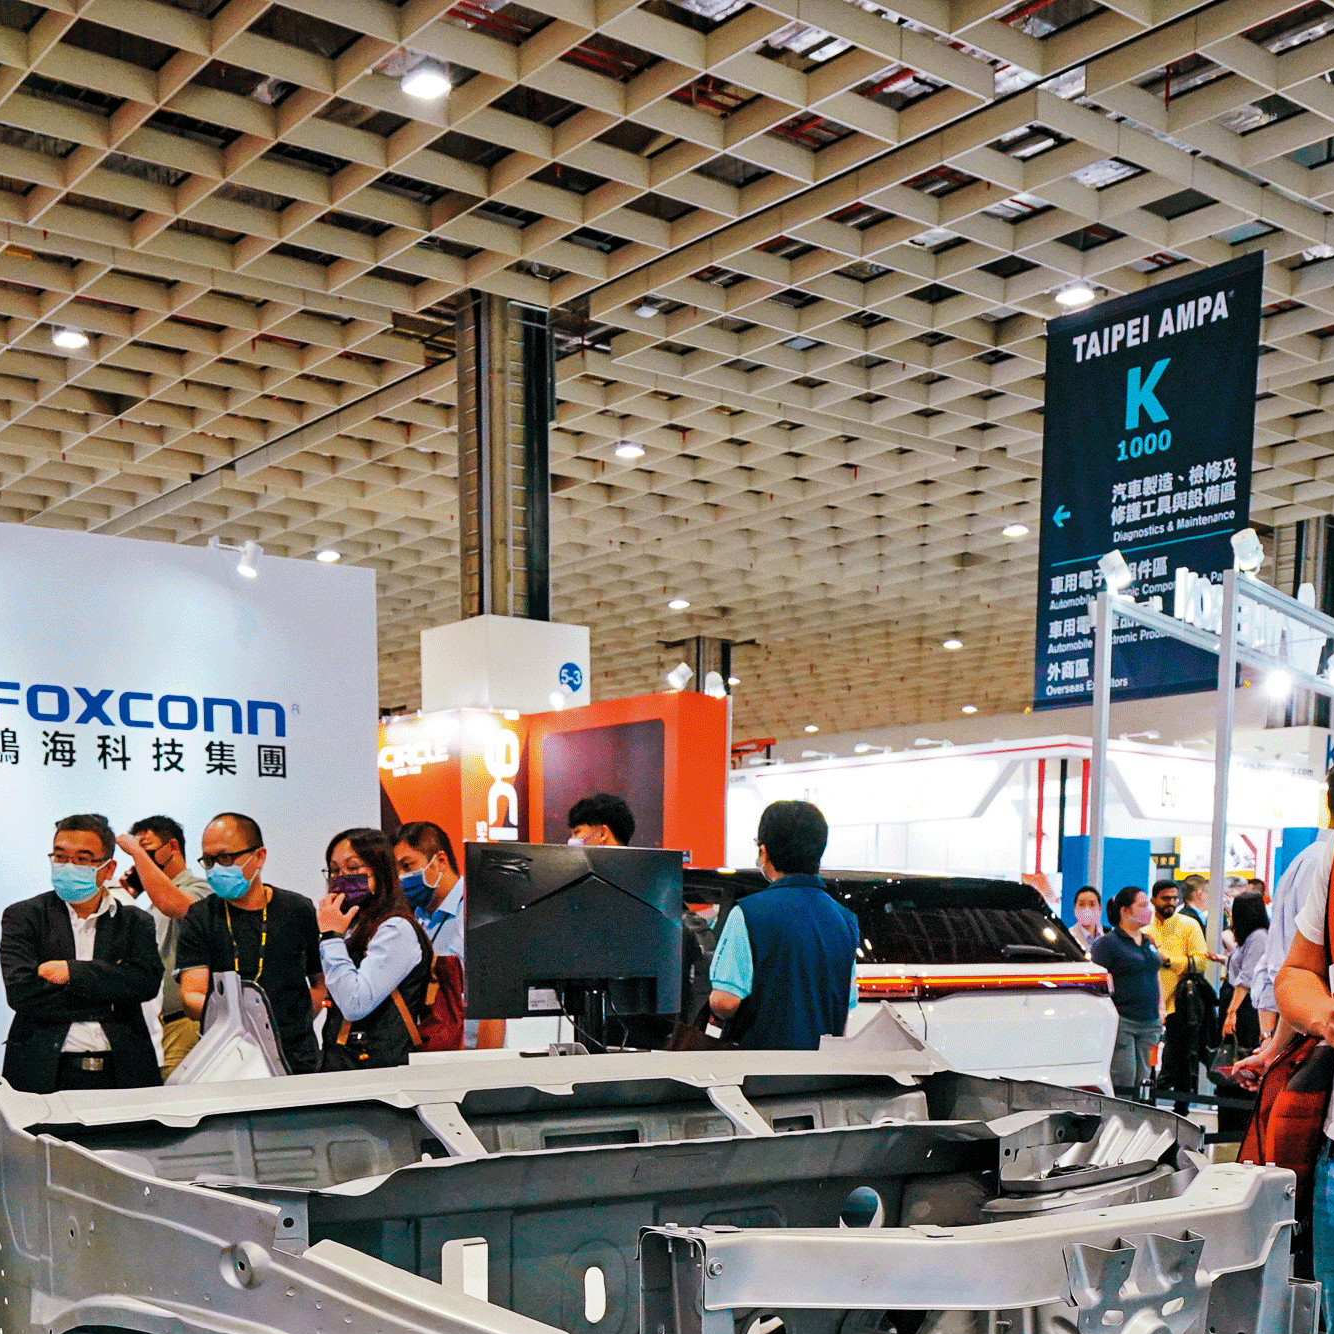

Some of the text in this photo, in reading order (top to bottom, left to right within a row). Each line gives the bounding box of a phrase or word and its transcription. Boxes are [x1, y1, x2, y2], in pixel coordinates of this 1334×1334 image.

[1073, 291, 1229, 363] TAIPEI AMPA
[1125, 357, 1171, 430] K
[1117, 429, 1172, 462] 1000
[1113, 509, 1236, 543] Diagnostics & Maintenance
[1047, 638, 1094, 654] Automobile
[560, 668, 582, 685] 5-3
[1047, 658, 1089, 681] 外商區
[1046, 682, 1085, 696] Overseas
